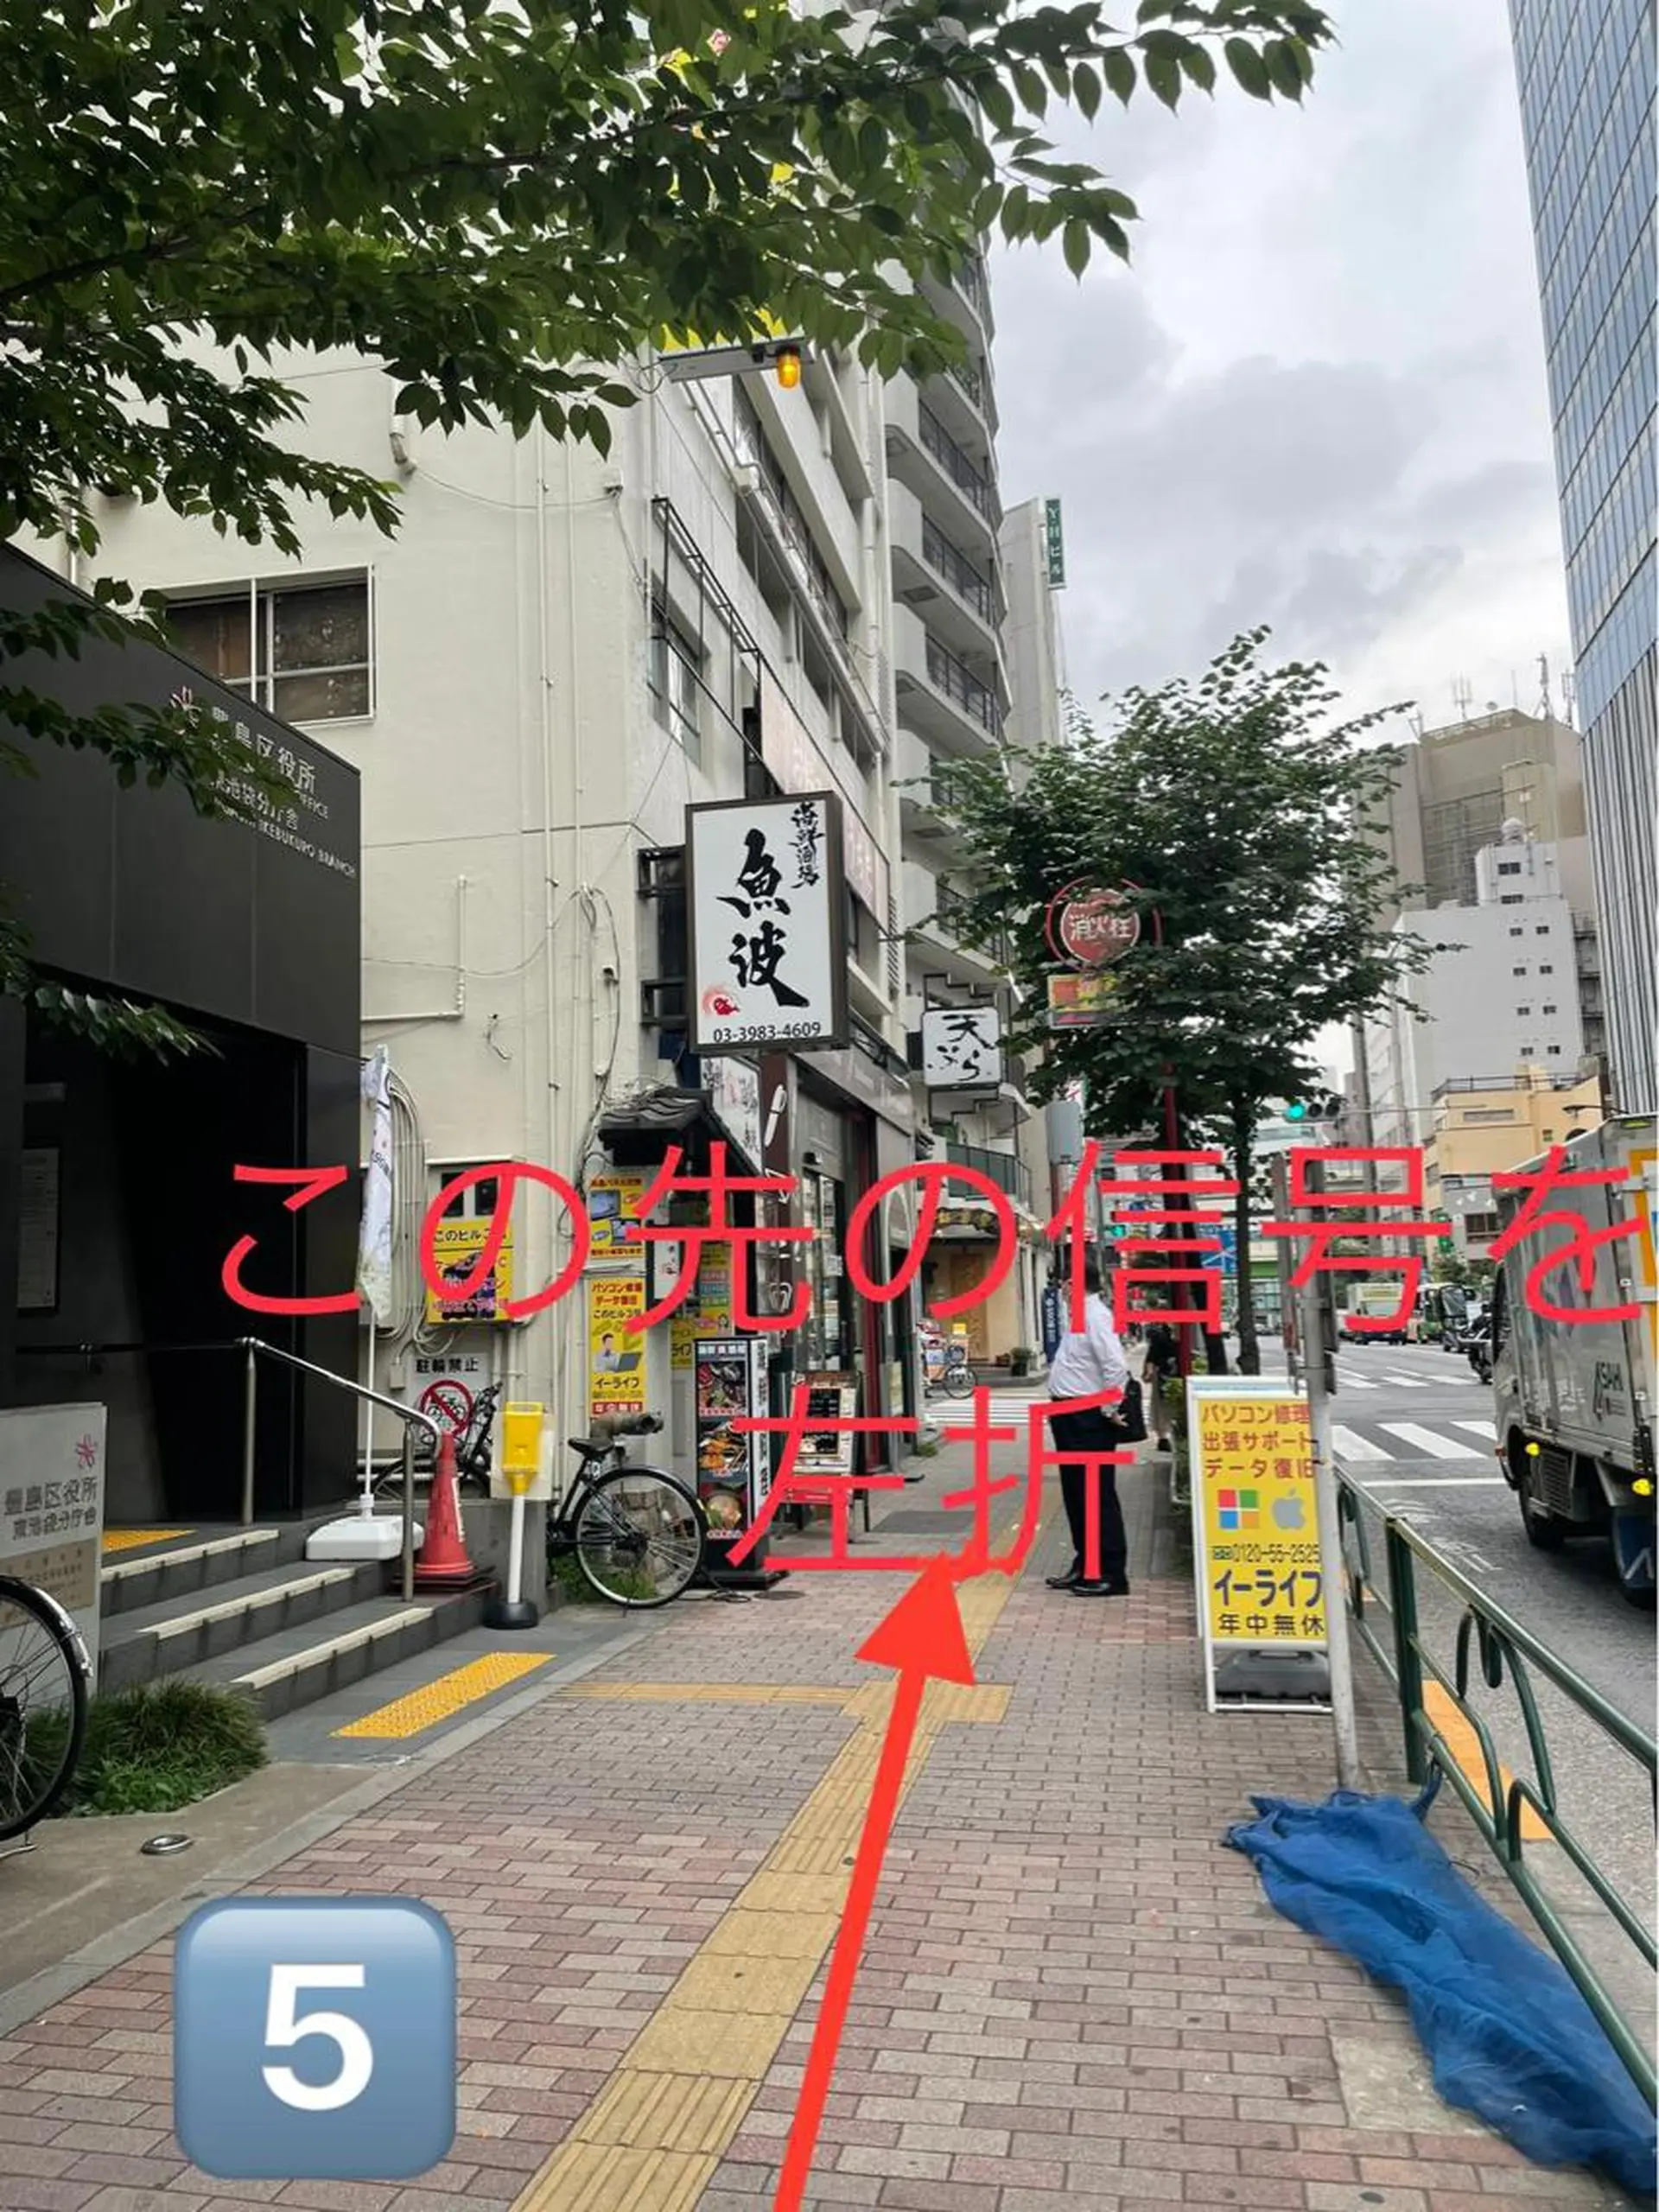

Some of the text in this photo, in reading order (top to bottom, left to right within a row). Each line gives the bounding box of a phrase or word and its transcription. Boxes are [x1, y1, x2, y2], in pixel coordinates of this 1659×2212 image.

[716, 828, 810, 1008] 魚波
[1069, 913, 1134, 941] 消火栓
[713, 1021, 822, 1043] 03-3983-4609
[416, 1357, 480, 1375] 駐輪禁止
[1202, 1430, 1315, 1453] 出張サポート
[1205, 1457, 1315, 1480] データ復旧
[5, 1476, 98, 1516] 豊島区役所
[1214, 1568, 1323, 1608] イーライフ
[1217, 1613, 1325, 1637] 年中無休
